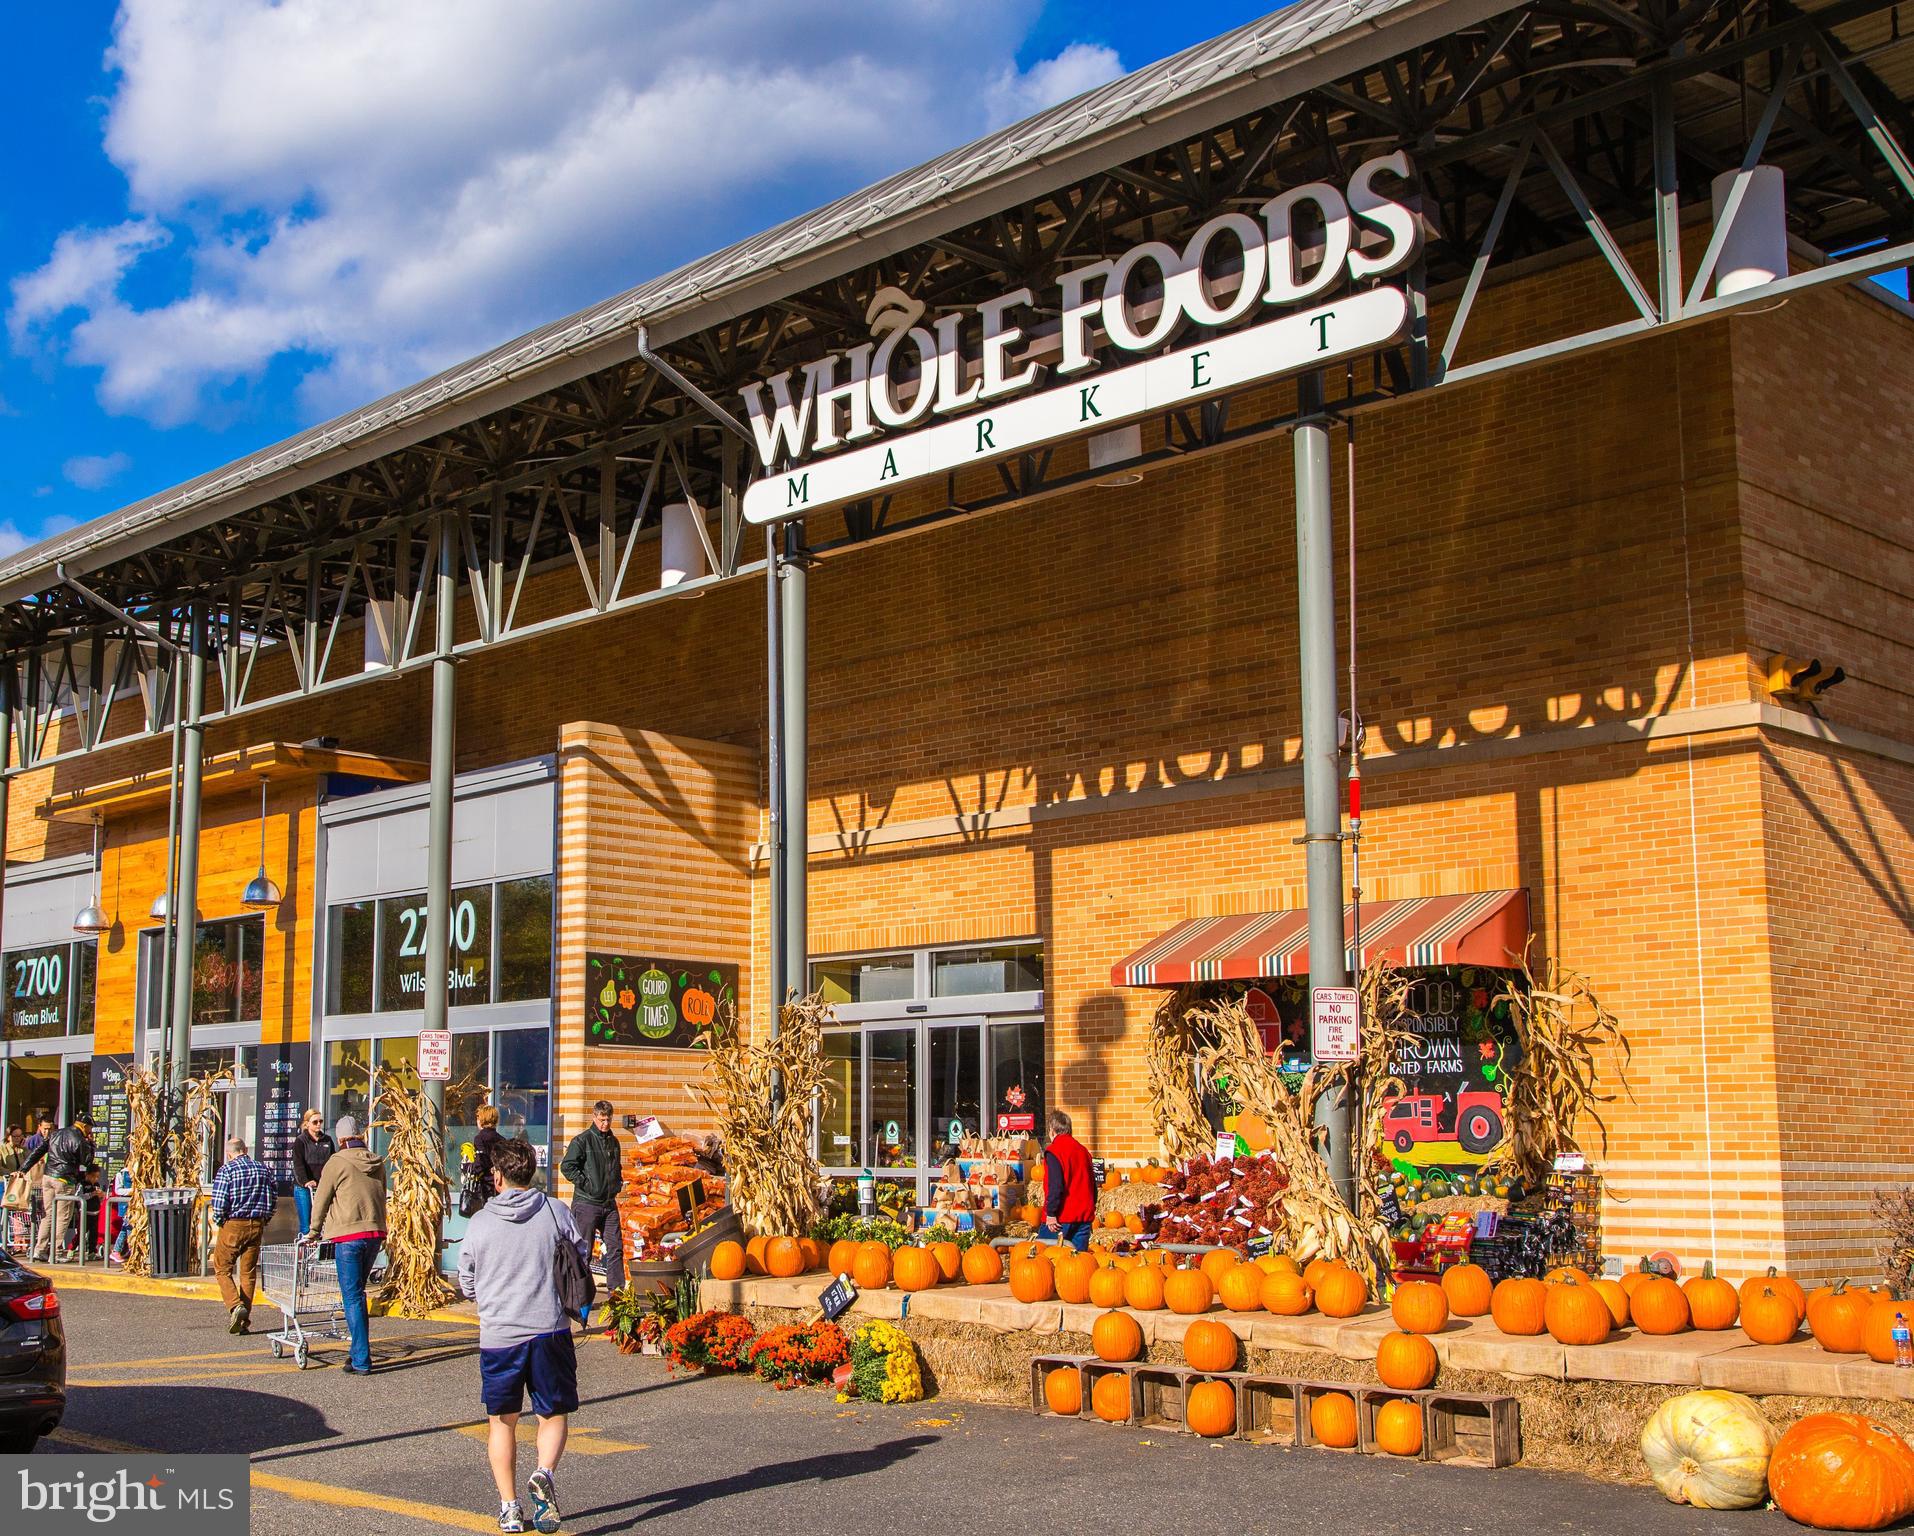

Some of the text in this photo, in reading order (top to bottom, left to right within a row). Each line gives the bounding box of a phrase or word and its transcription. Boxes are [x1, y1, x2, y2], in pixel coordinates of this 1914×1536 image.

[738, 151, 1424, 467] WHOLE FOODS
[786, 312, 1336, 508] MARKET
[399, 900, 475, 957] 270
[14, 954, 61, 998] 2700
[399, 971, 426, 993] Wils
[642, 978, 668, 996] GOURD
[13, 1007, 59, 1026] Wilson Blvd.
[643, 1004, 669, 1027] TIMES
[1329, 1004, 1342, 1013] NO
[1318, 1015, 1353, 1024] PARKING
[1327, 1034, 1344, 1042] LANE
[1427, 1059, 1463, 1074] FARMS
